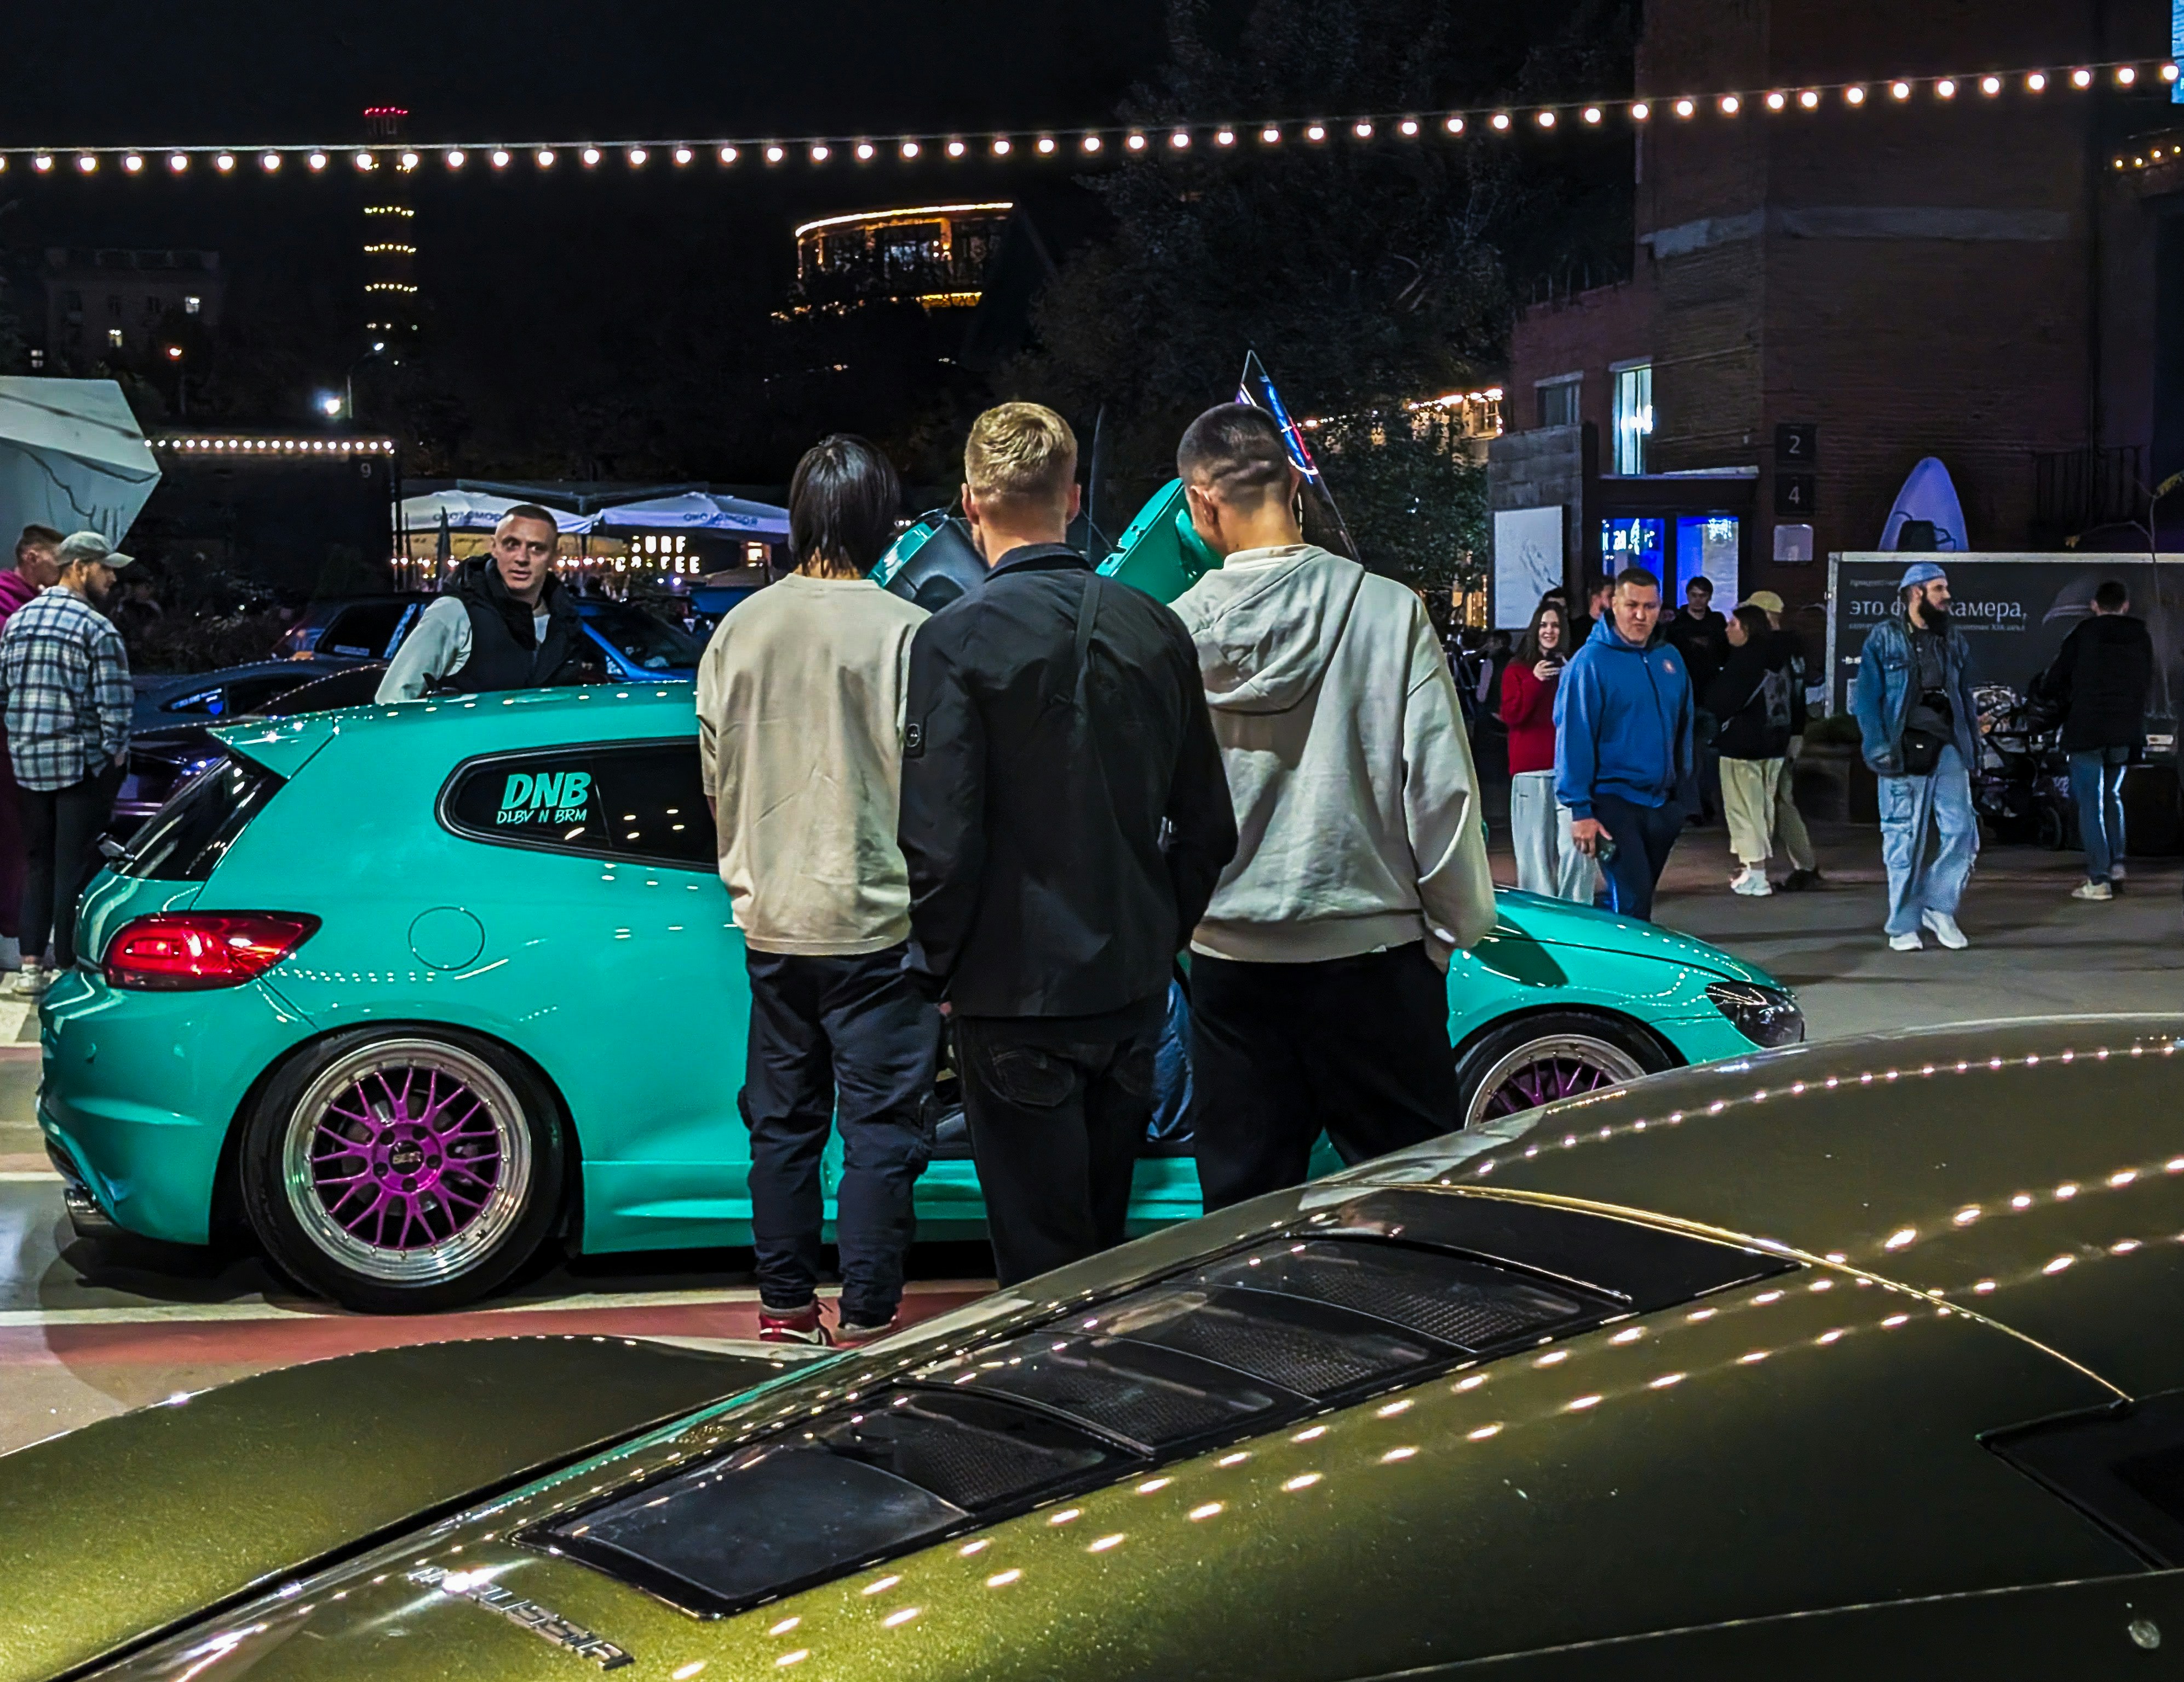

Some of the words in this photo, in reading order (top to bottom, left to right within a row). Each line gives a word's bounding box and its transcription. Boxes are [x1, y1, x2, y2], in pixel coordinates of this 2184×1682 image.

[1789, 435, 1801, 454] 2
[360, 463, 371, 478] 9
[1788, 485, 1800, 504] 4
[1849, 601, 1884, 615] это
[501, 771, 592, 810] DNB
[538, 809, 550, 823] N
[554, 808, 588, 824] BRM
